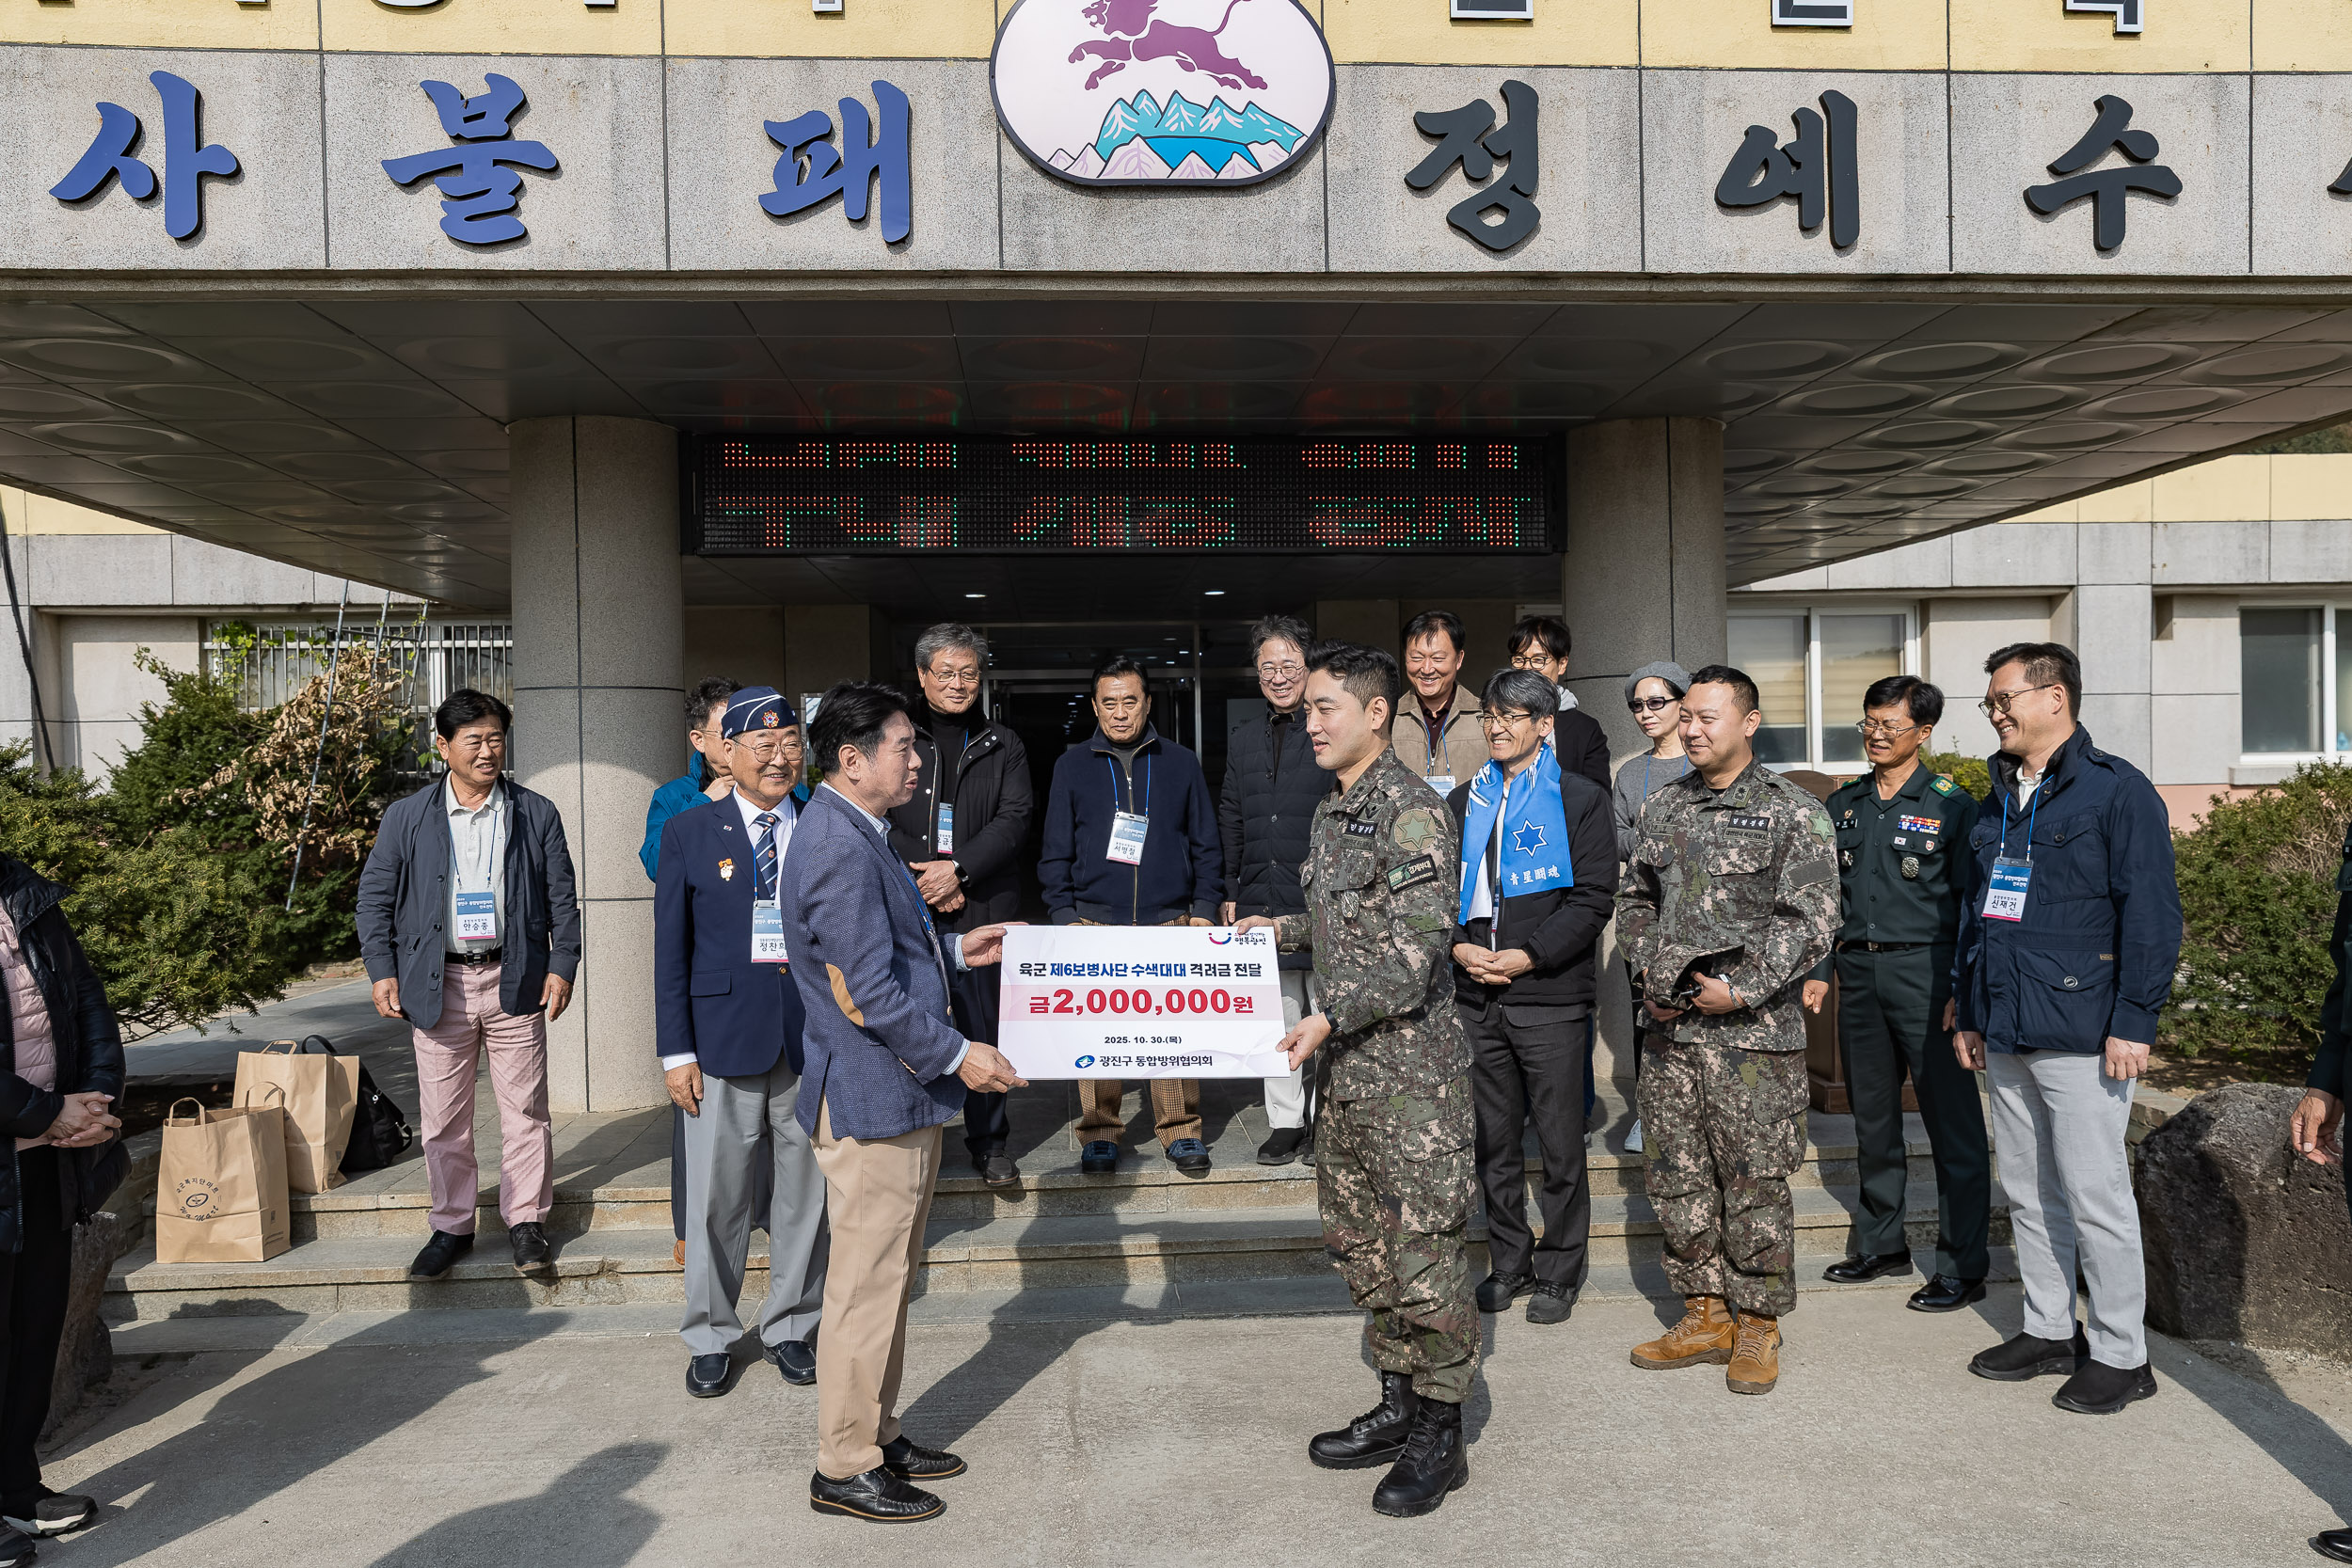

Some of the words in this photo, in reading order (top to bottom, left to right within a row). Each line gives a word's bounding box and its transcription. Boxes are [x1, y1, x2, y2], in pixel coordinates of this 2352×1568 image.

[1019, 963, 1047, 977] 육군
[1050, 962, 1128, 977] 제6보병사단
[1131, 962, 1186, 977] 수색대대
[1190, 962, 1231, 977] 격려금
[1234, 962, 1263, 977] 전달
[1028, 988, 1255, 1016] 금2,000,000원
[1104, 1036, 1131, 1044] 2025.
[1134, 1036, 1149, 1044] 10.
[1151, 1036, 1183, 1045] 30.(목)
[1099, 1054, 1133, 1068] 광진구
[1136, 1054, 1214, 1068] 통합방위협의회
